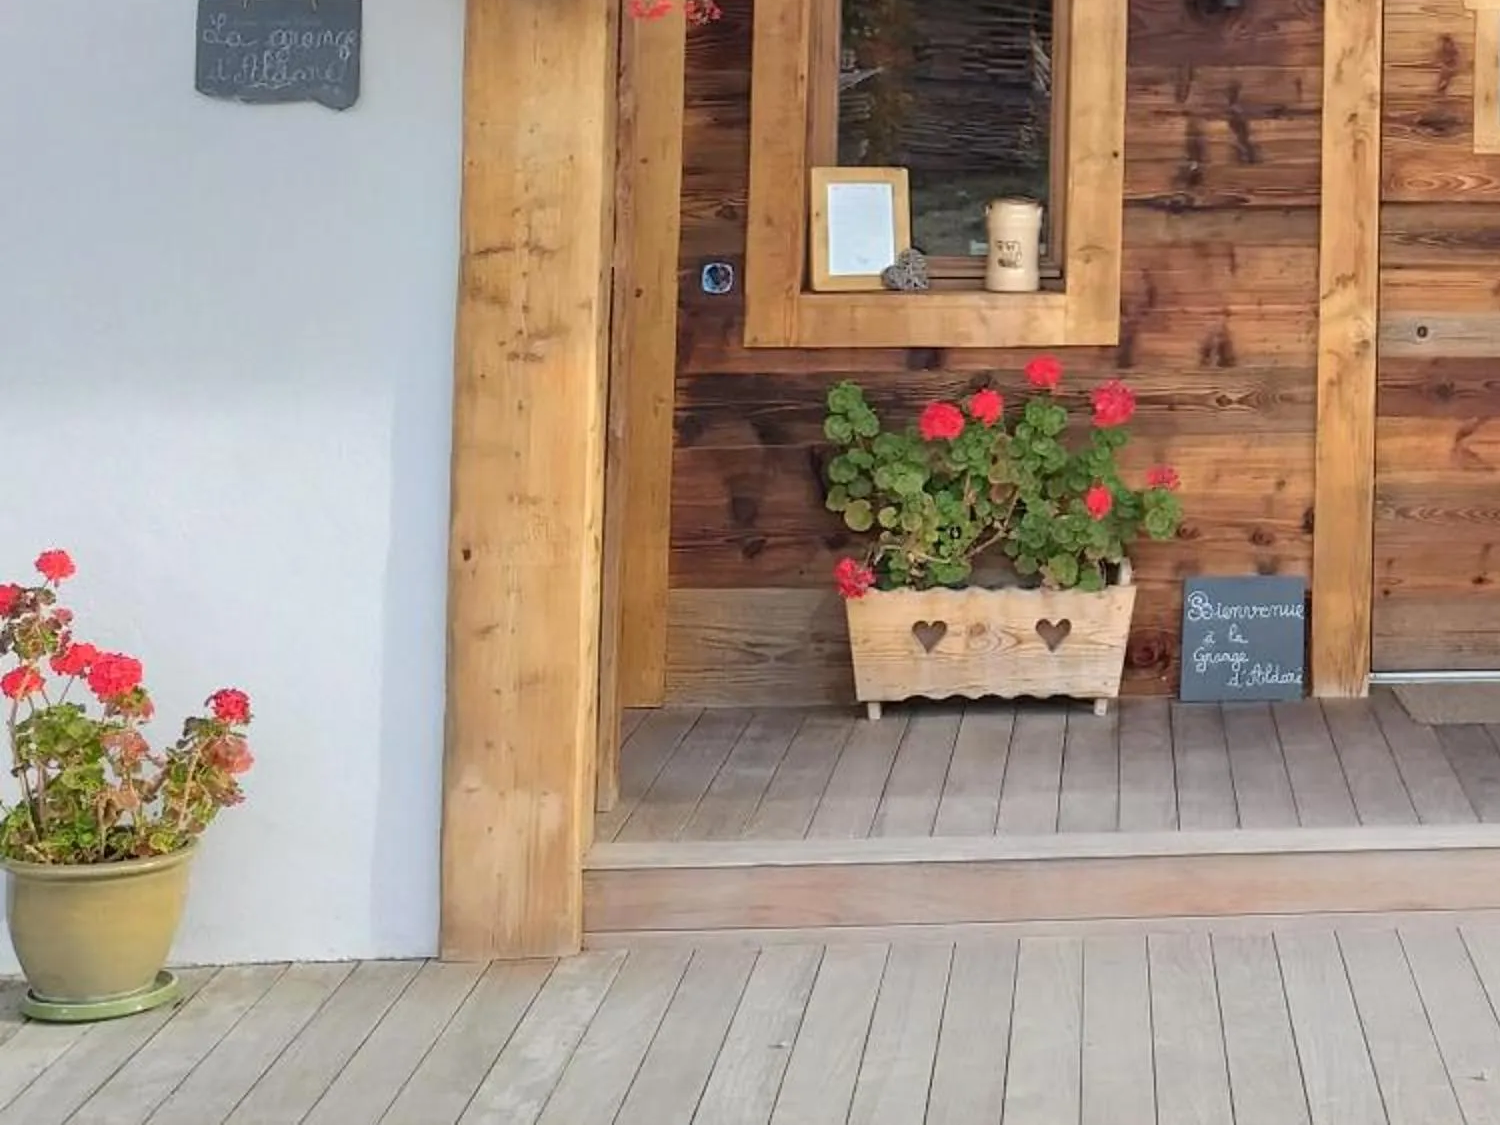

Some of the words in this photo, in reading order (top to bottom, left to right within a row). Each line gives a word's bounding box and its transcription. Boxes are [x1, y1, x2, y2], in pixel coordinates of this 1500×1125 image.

[1187, 590, 1304, 621] Bienvenue
[1228, 623, 1249, 644] la
[1193, 647, 1249, 673] Grange
